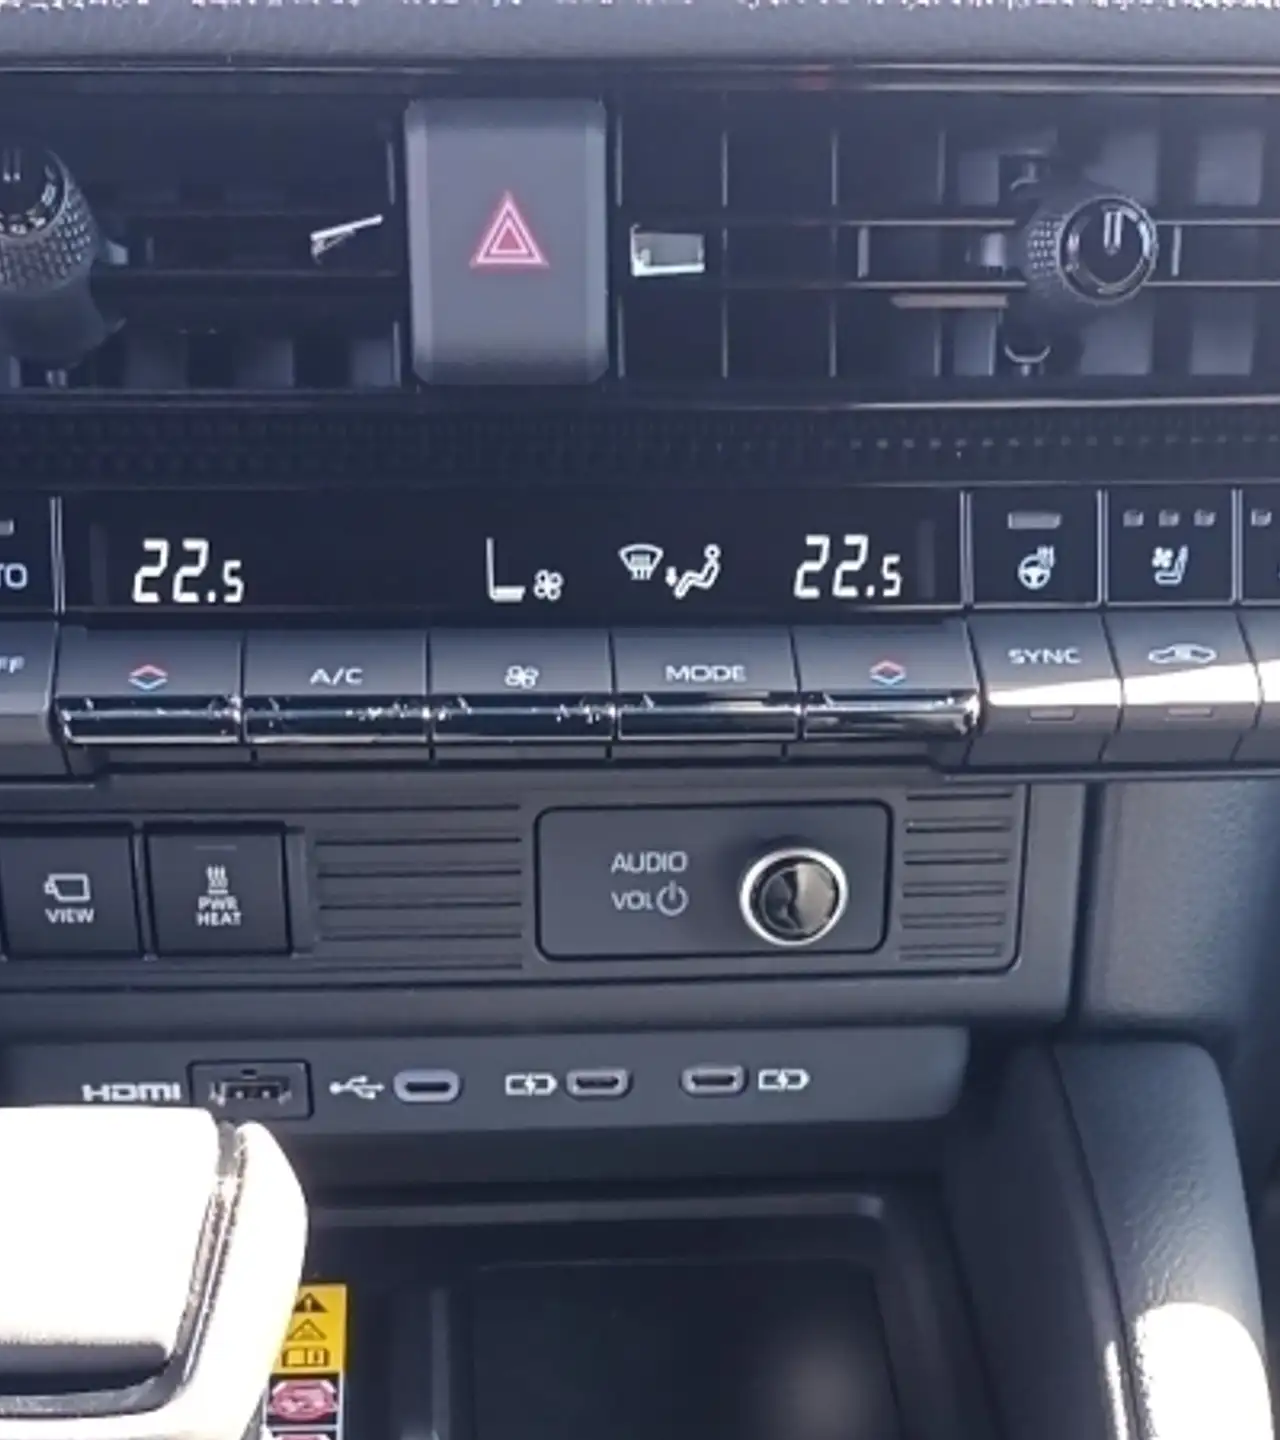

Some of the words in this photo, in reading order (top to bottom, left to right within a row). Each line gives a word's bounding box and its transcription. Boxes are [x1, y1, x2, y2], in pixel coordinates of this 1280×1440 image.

[132, 538, 245, 603] 22.5
[793, 534, 902, 599] 22.5
[1008, 648, 1082, 665] SYNC
[310, 668, 363, 686] A/C
[665, 664, 747, 682] MODE
[611, 851, 688, 873] AUDIO
[610, 889, 654, 911] VOL
[45, 909, 95, 923] VIEW
[196, 911, 241, 926] HEAT
